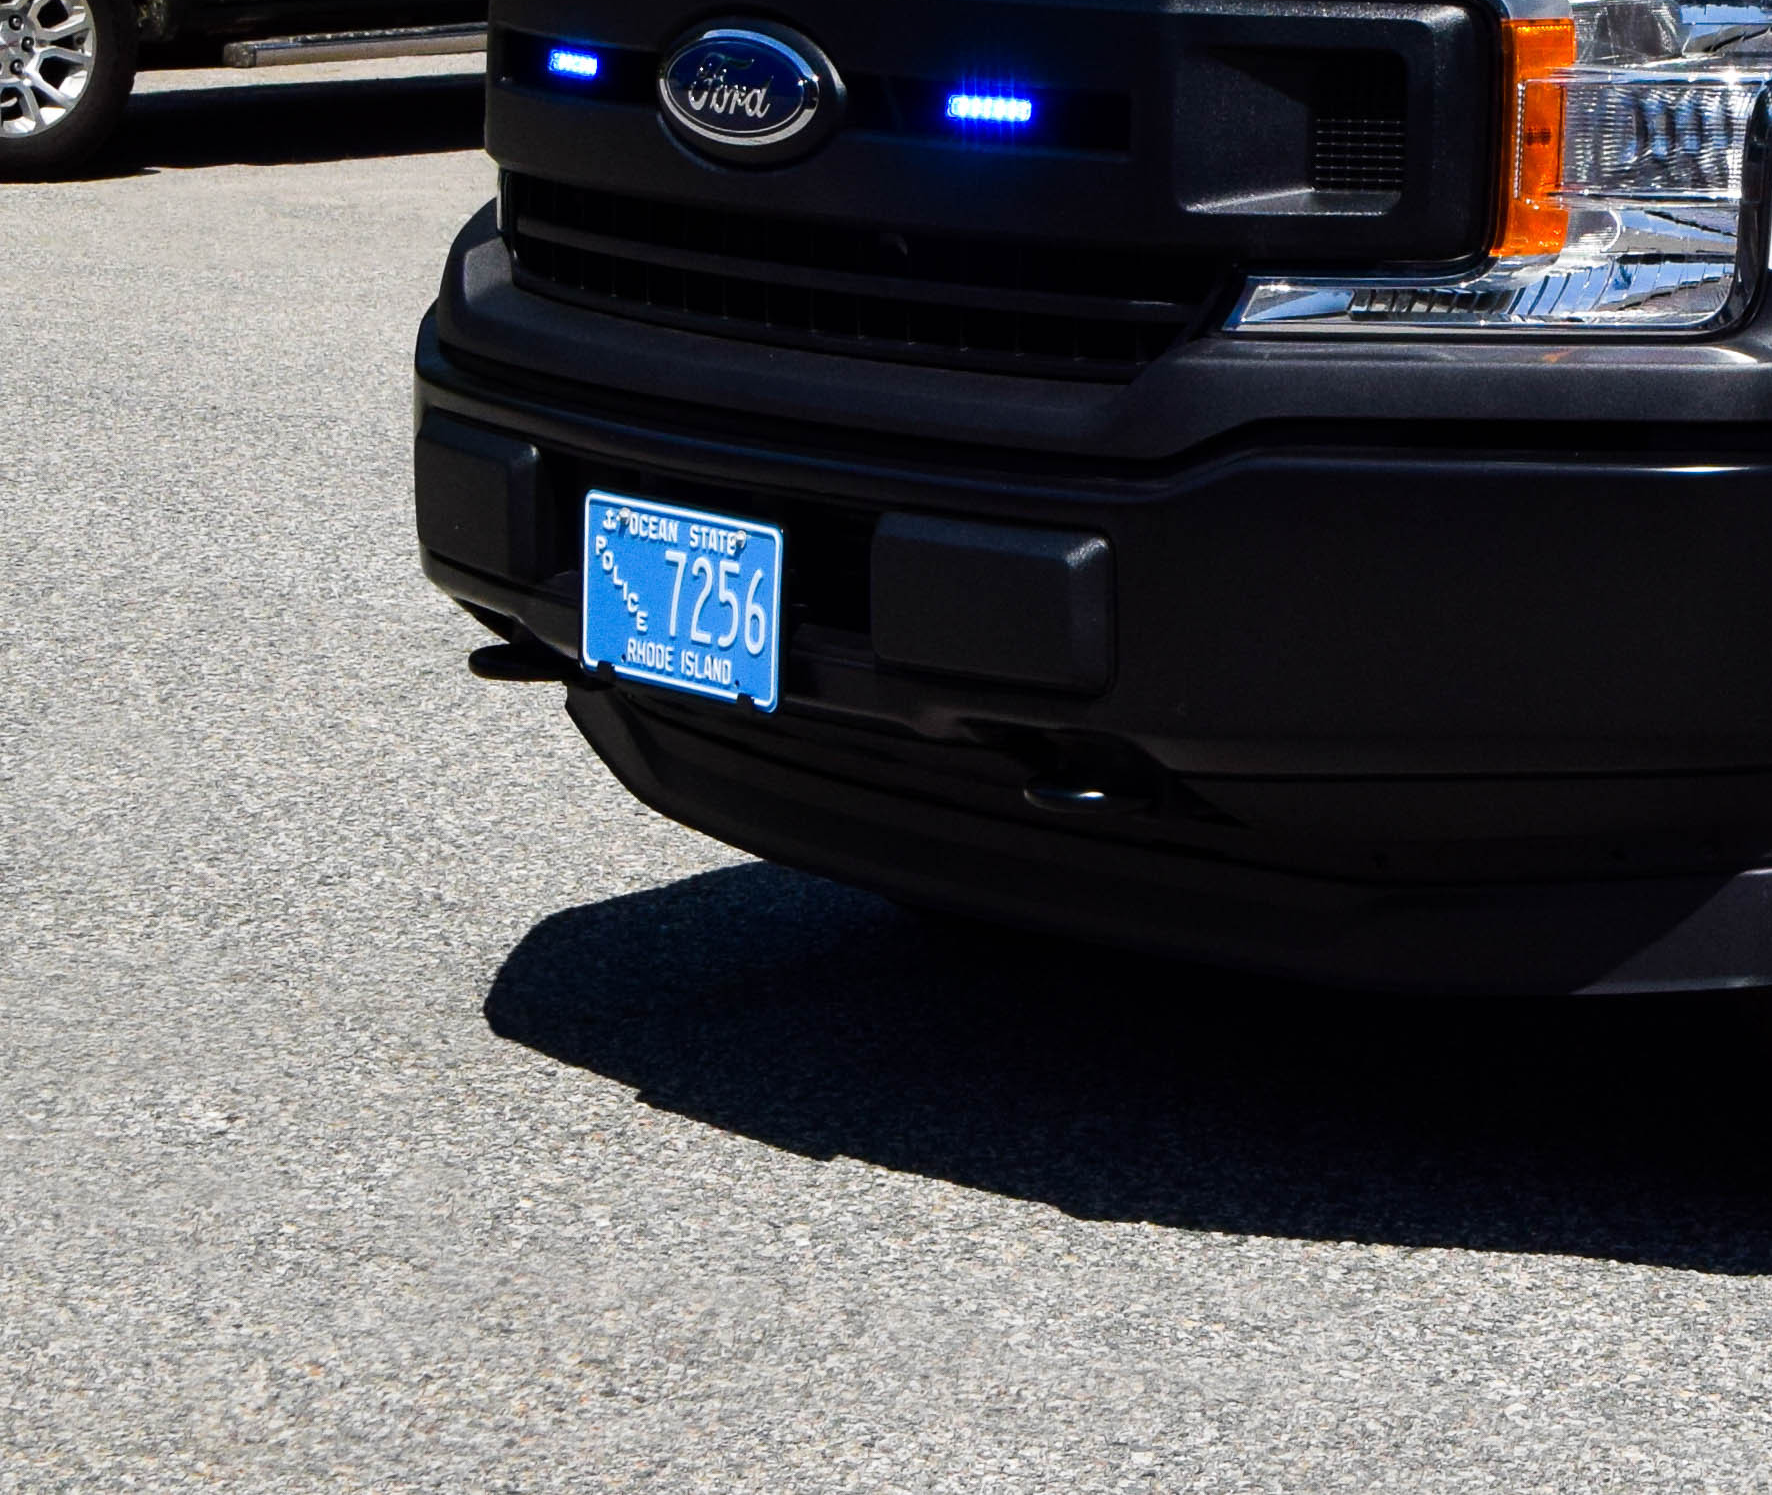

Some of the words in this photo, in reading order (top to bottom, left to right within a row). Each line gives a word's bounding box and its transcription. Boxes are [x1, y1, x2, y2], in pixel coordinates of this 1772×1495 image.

[688, 52, 774, 119] Ford
[629, 511, 679, 544] OCEAN
[689, 524, 738, 556] STATE
[595, 535, 648, 632] POLICE
[664, 549, 766, 655] 7256
[627, 638, 674, 673] RHODE
[680, 650, 733, 686] ISLAND
